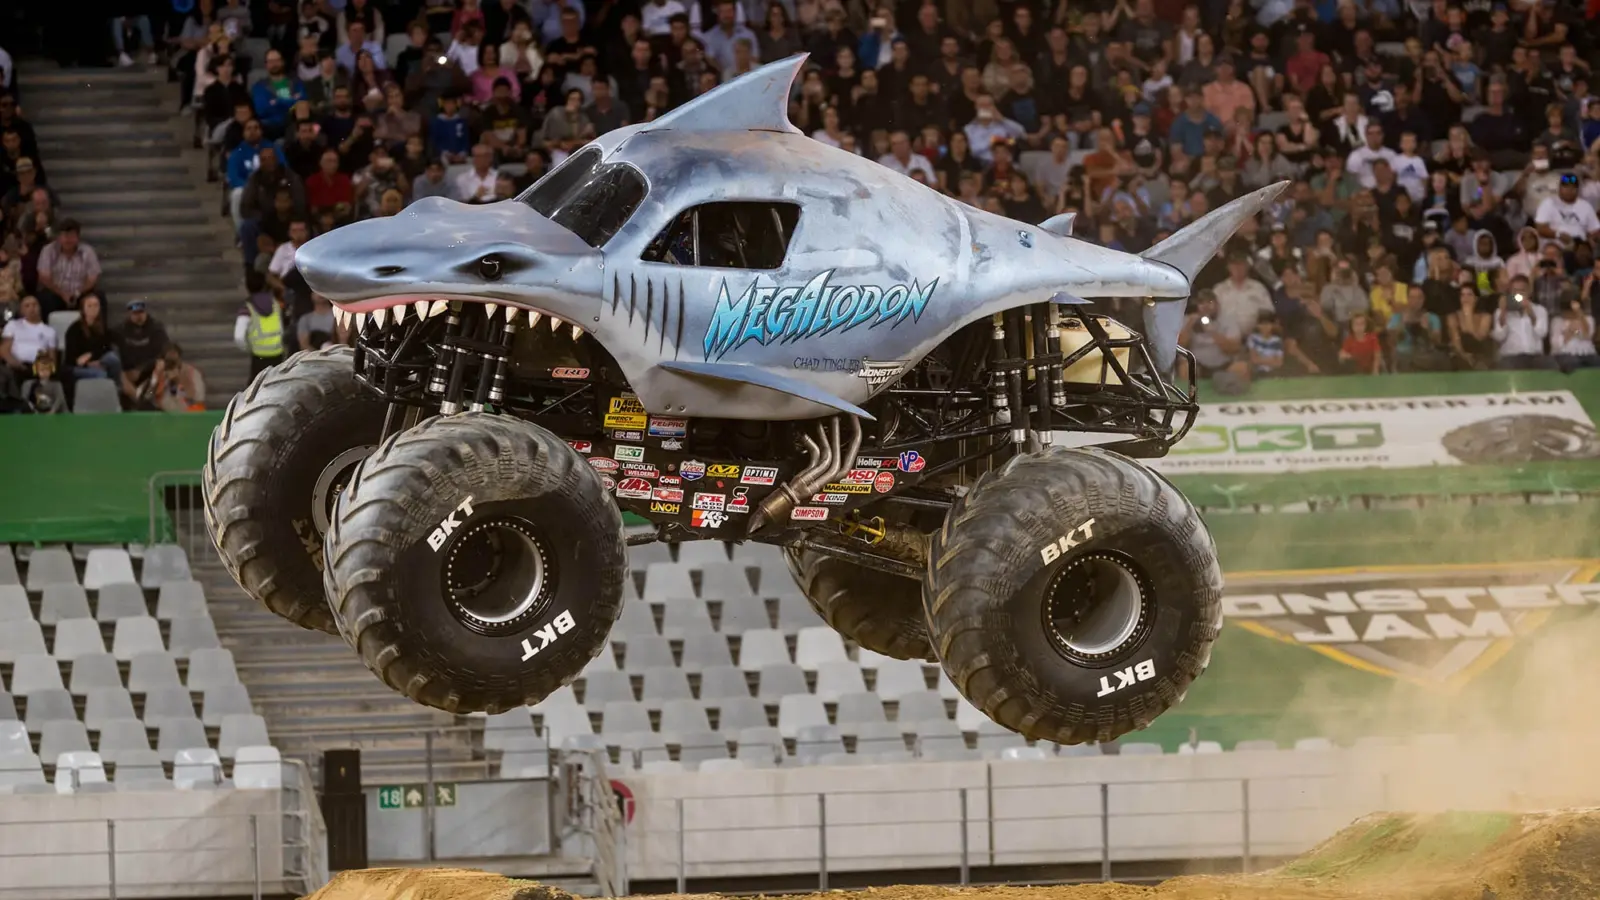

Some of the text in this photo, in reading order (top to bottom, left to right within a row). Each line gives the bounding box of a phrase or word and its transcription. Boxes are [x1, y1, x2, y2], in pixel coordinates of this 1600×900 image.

[703, 268, 940, 362] MEGALODON
[794, 357, 820, 372] CHAD
[859, 368, 904, 378] MONSTER
[868, 377, 889, 385] JAM
[1281, 400, 1466, 415] MONSTER
[1486, 394, 1566, 407] JAM
[622, 463, 653, 471] LINCOLN
[858, 458, 882, 468] Holley
[900, 451, 919, 472] VP
[660, 476, 680, 484] Coan
[746, 469, 775, 478] OPTIMA
[847, 470, 875, 480] MSD
[651, 503, 680, 513] UNOH
[794, 509, 825, 518] SIMPSON
[427, 496, 476, 552] BKT
[1041, 518, 1096, 566] BKT
[1221, 583, 1600, 616] ONSTER
[1294, 610, 1513, 642] JAM
[520, 609, 576, 662] BKT
[1097, 659, 1156, 698] BKT
[380, 790, 400, 805] 18
